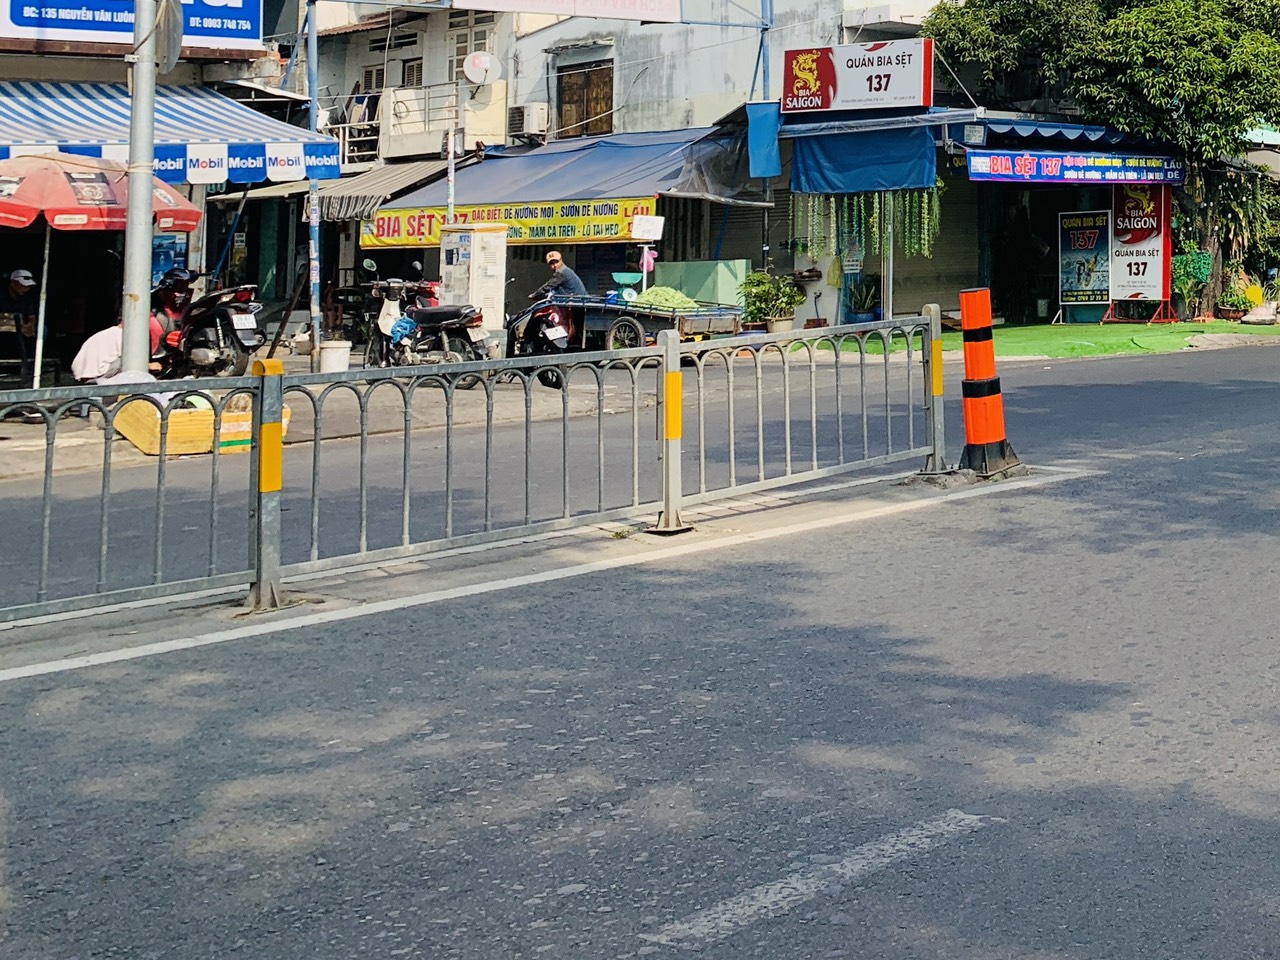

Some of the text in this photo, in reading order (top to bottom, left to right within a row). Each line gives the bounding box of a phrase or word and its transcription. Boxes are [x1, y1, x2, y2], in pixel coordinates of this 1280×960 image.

[40, 8, 57, 19] 135
[58, 6, 93, 21] NGUYỄN
[113, 11, 135, 23] LUÔN
[846, 51, 913, 69] QUÁN BIA SỆT
[866, 73, 891, 92] 137
[798, 89, 810, 97] BIA
[786, 96, 822, 109] SAIGON
[188, 157, 224, 169] Mobil
[228, 156, 264, 169] Mobil
[268, 156, 301, 168] Mobil
[305, 154, 338, 167] Mobil
[990, 155, 1013, 175] BIA
[1015, 152, 1038, 179] SỆT
[1040, 157, 1062, 176] 137
[514, 205, 538, 220] NƯỚNG
[540, 206, 554, 221] MỌI
[593, 201, 619, 216] NƯỚNG
[1131, 209, 1143, 217] BIA
[375, 216, 401, 238] BIA
[406, 210, 435, 241] SỆT
[1117, 217, 1158, 229] SAIGON
[592, 224, 603, 237] TAI
[605, 223, 619, 237] HEO
[1070, 230, 1099, 250] 137
[1115, 247, 1135, 257] QUÁN
[1135, 249, 1147, 257] BIA
[1126, 262, 1148, 276] 137
